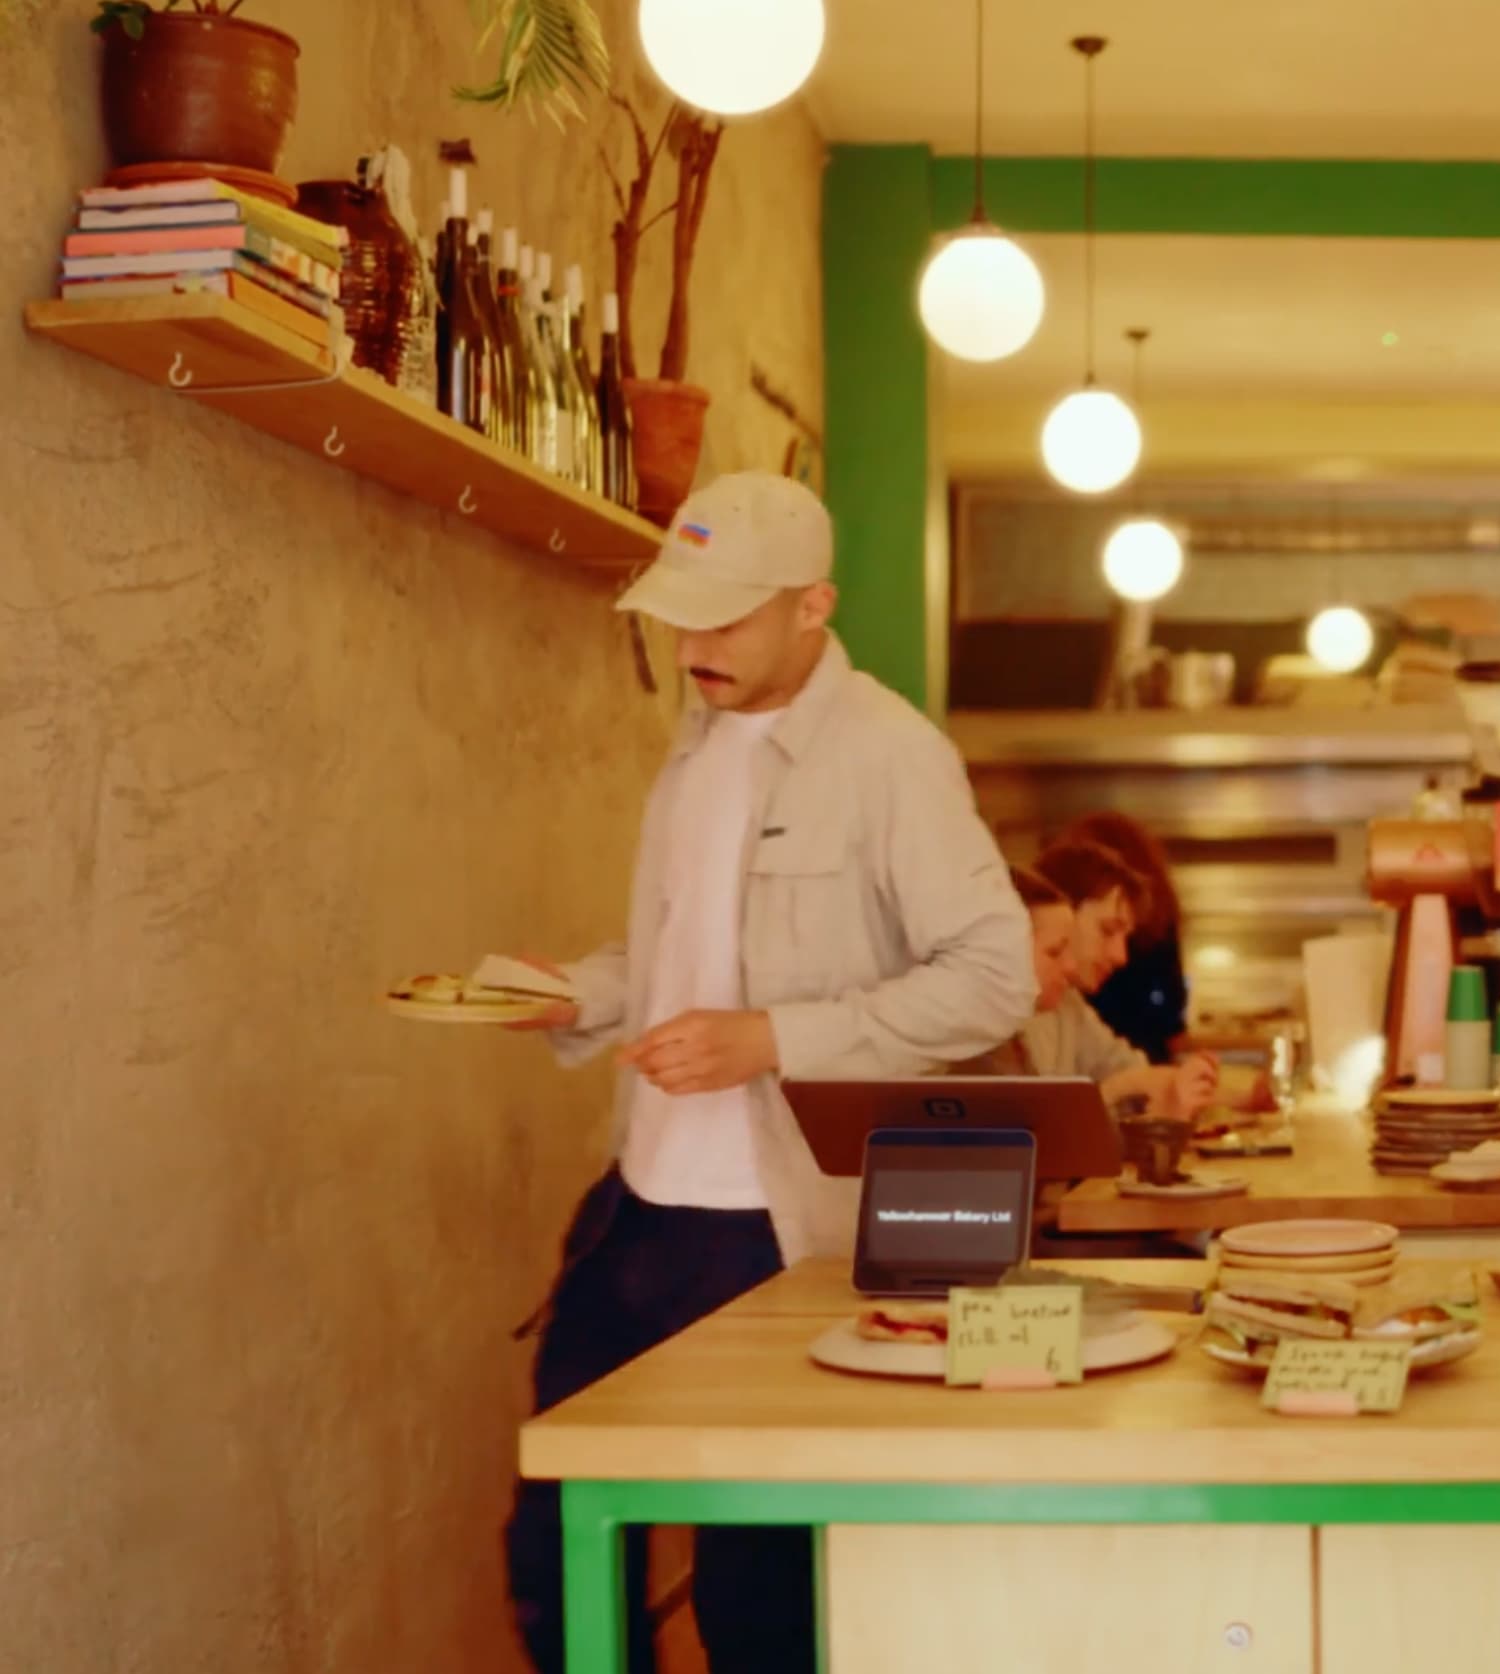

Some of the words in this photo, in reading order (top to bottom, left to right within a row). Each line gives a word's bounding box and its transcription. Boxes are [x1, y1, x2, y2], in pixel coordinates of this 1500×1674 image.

[877, 1209, 951, 1222] Yellowhammer
[953, 1209, 990, 1224] Bakery
[992, 1210, 1011, 1222] Ltd
